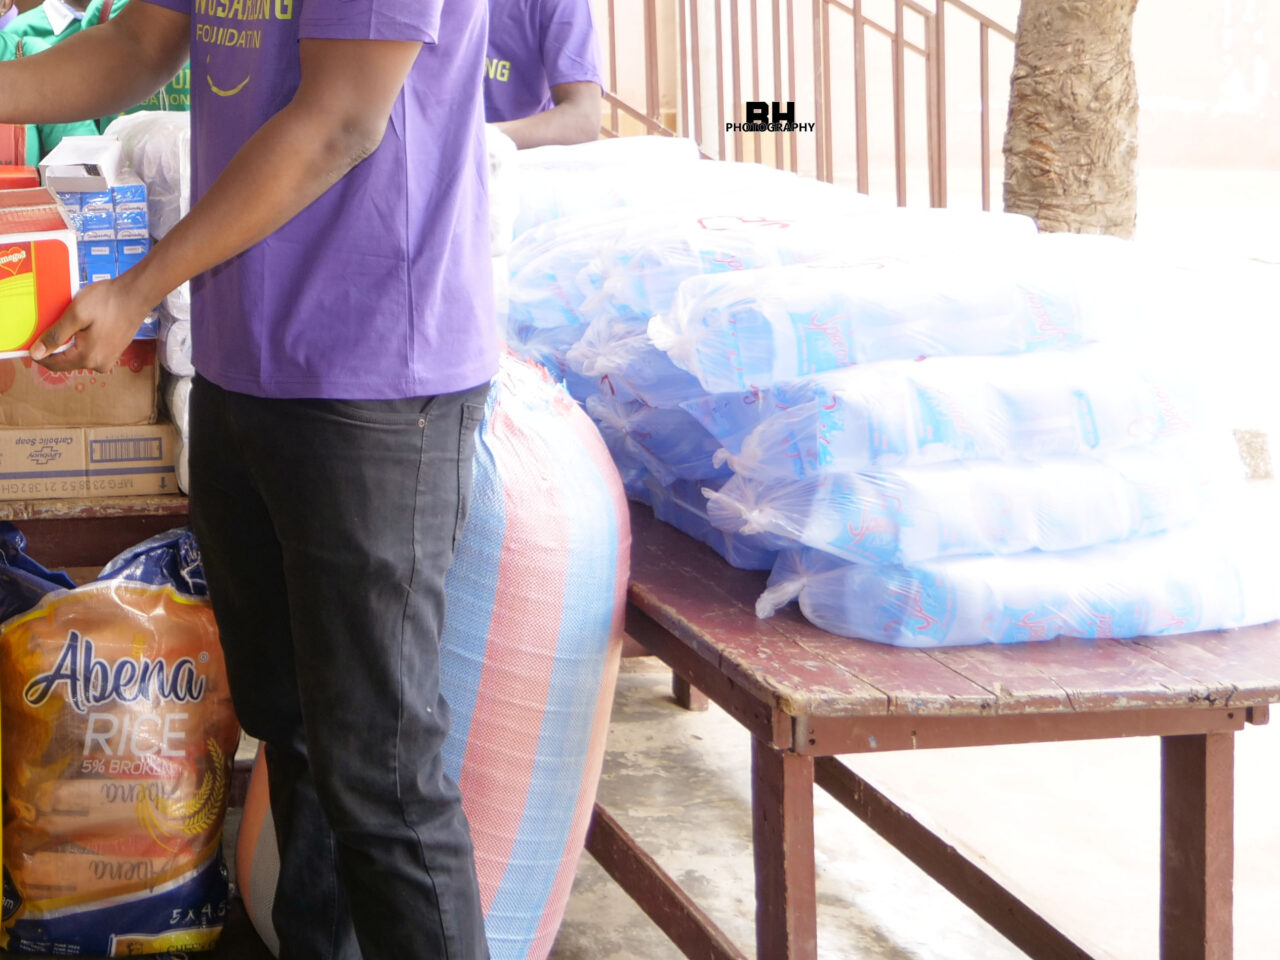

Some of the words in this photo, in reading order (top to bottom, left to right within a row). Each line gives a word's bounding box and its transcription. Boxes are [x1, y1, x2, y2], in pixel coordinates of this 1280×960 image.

[15, 437, 37, 445] Soap
[23, 629, 205, 715] Abena
[82, 713, 189, 757] RICE
[81, 759, 106, 774] 5%
